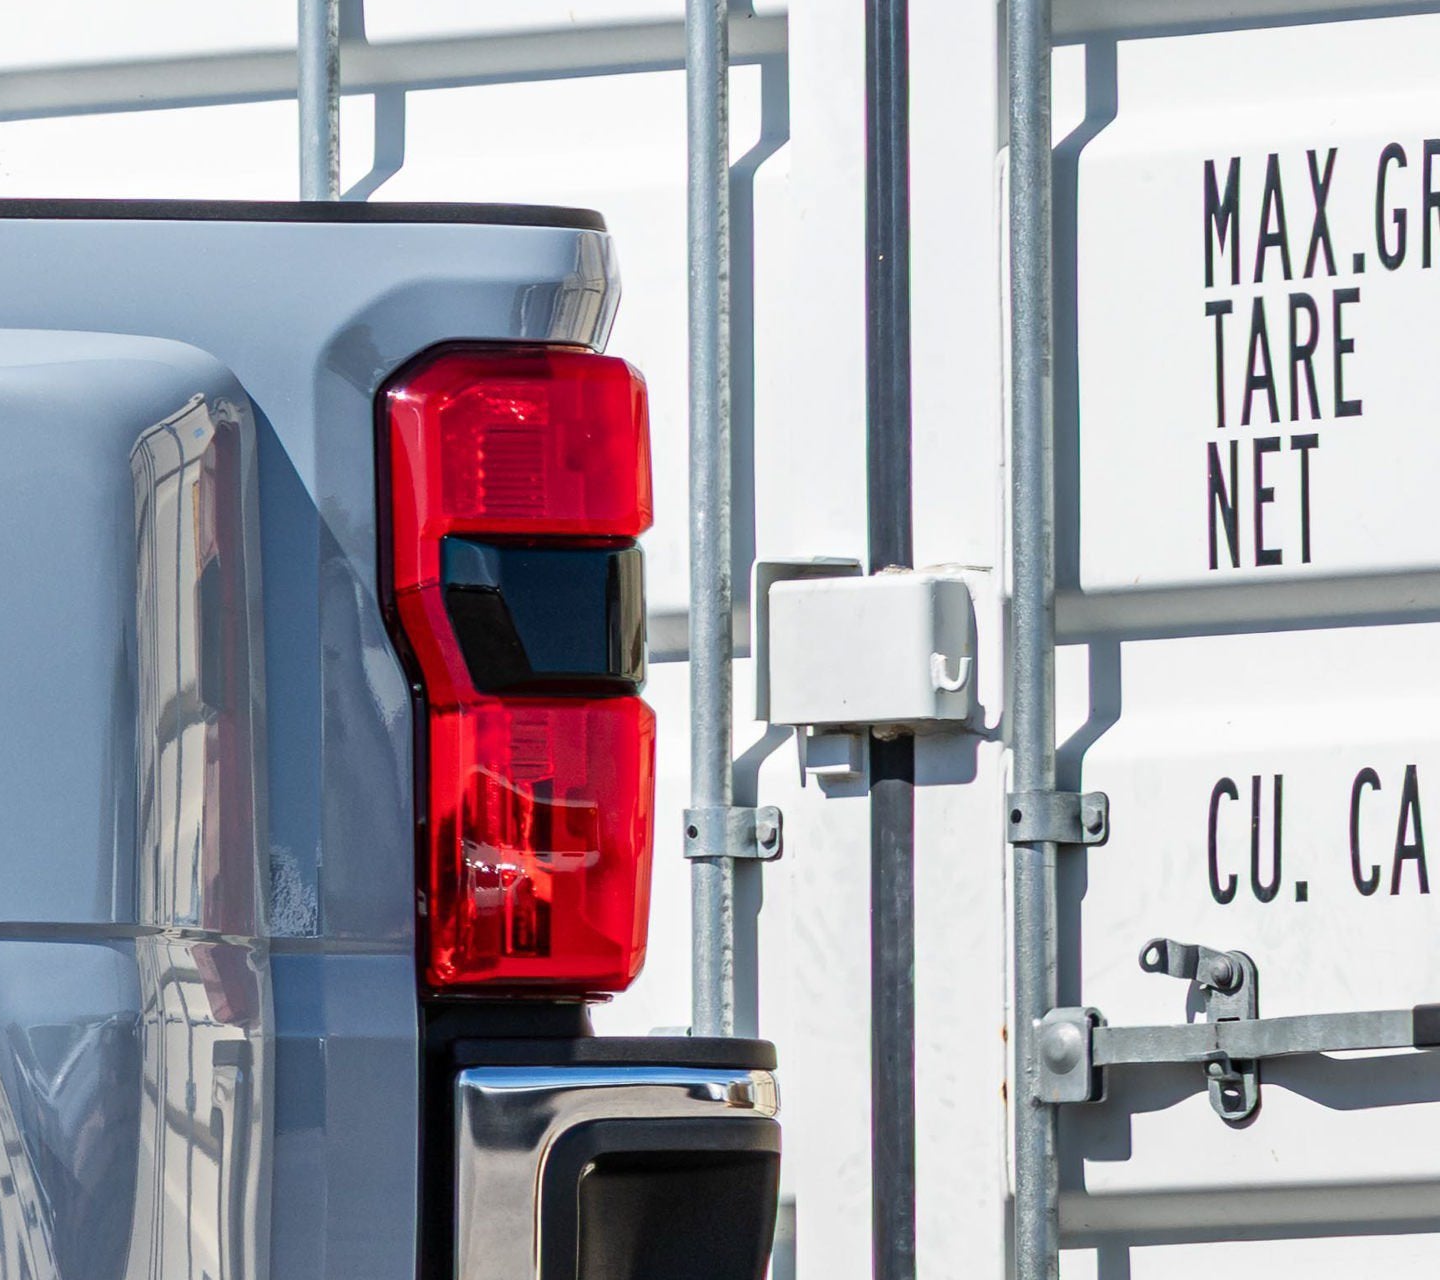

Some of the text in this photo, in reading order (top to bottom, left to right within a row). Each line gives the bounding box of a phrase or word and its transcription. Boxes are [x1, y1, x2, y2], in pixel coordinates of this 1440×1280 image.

[1204, 287, 1363, 429] TARE
[1208, 433, 1319, 570] NET
[1208, 764, 1431, 905] CU. CA
